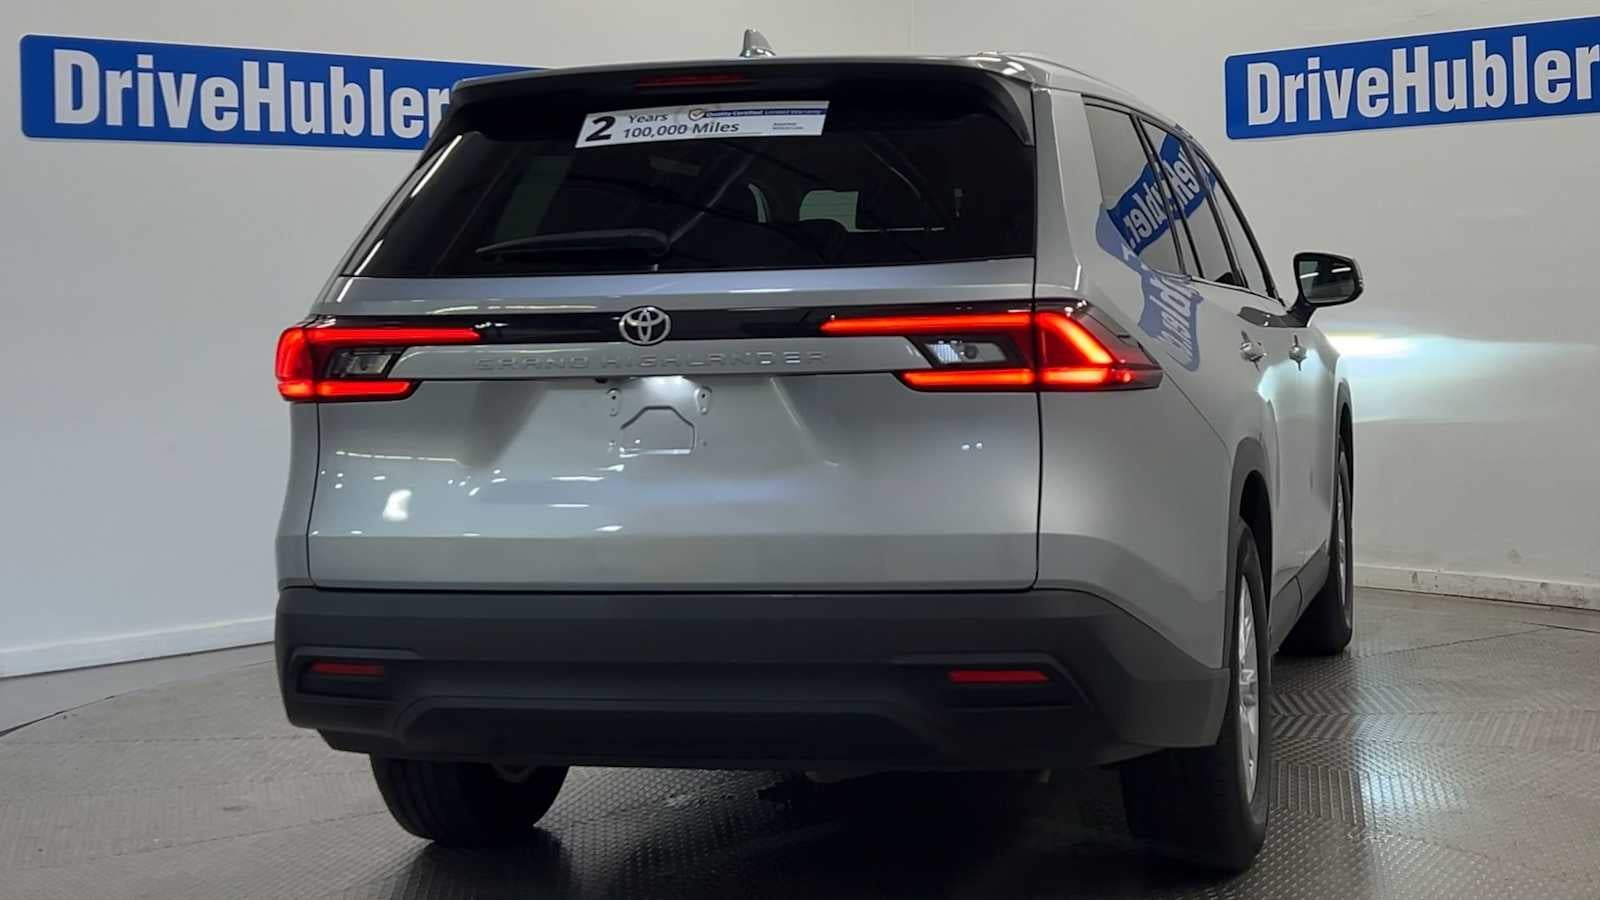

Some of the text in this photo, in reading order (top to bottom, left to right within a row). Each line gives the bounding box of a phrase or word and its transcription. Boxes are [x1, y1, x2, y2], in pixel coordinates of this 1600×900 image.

[1247, 35, 1600, 126] DriveHubler
[53, 48, 450, 139] DriveHubler
[585, 116, 616, 142] 2
[628, 112, 669, 124] Years
[623, 121, 740, 139] 100,000 Miles
[475, 350, 828, 371] GRAND HIGHLANDER
